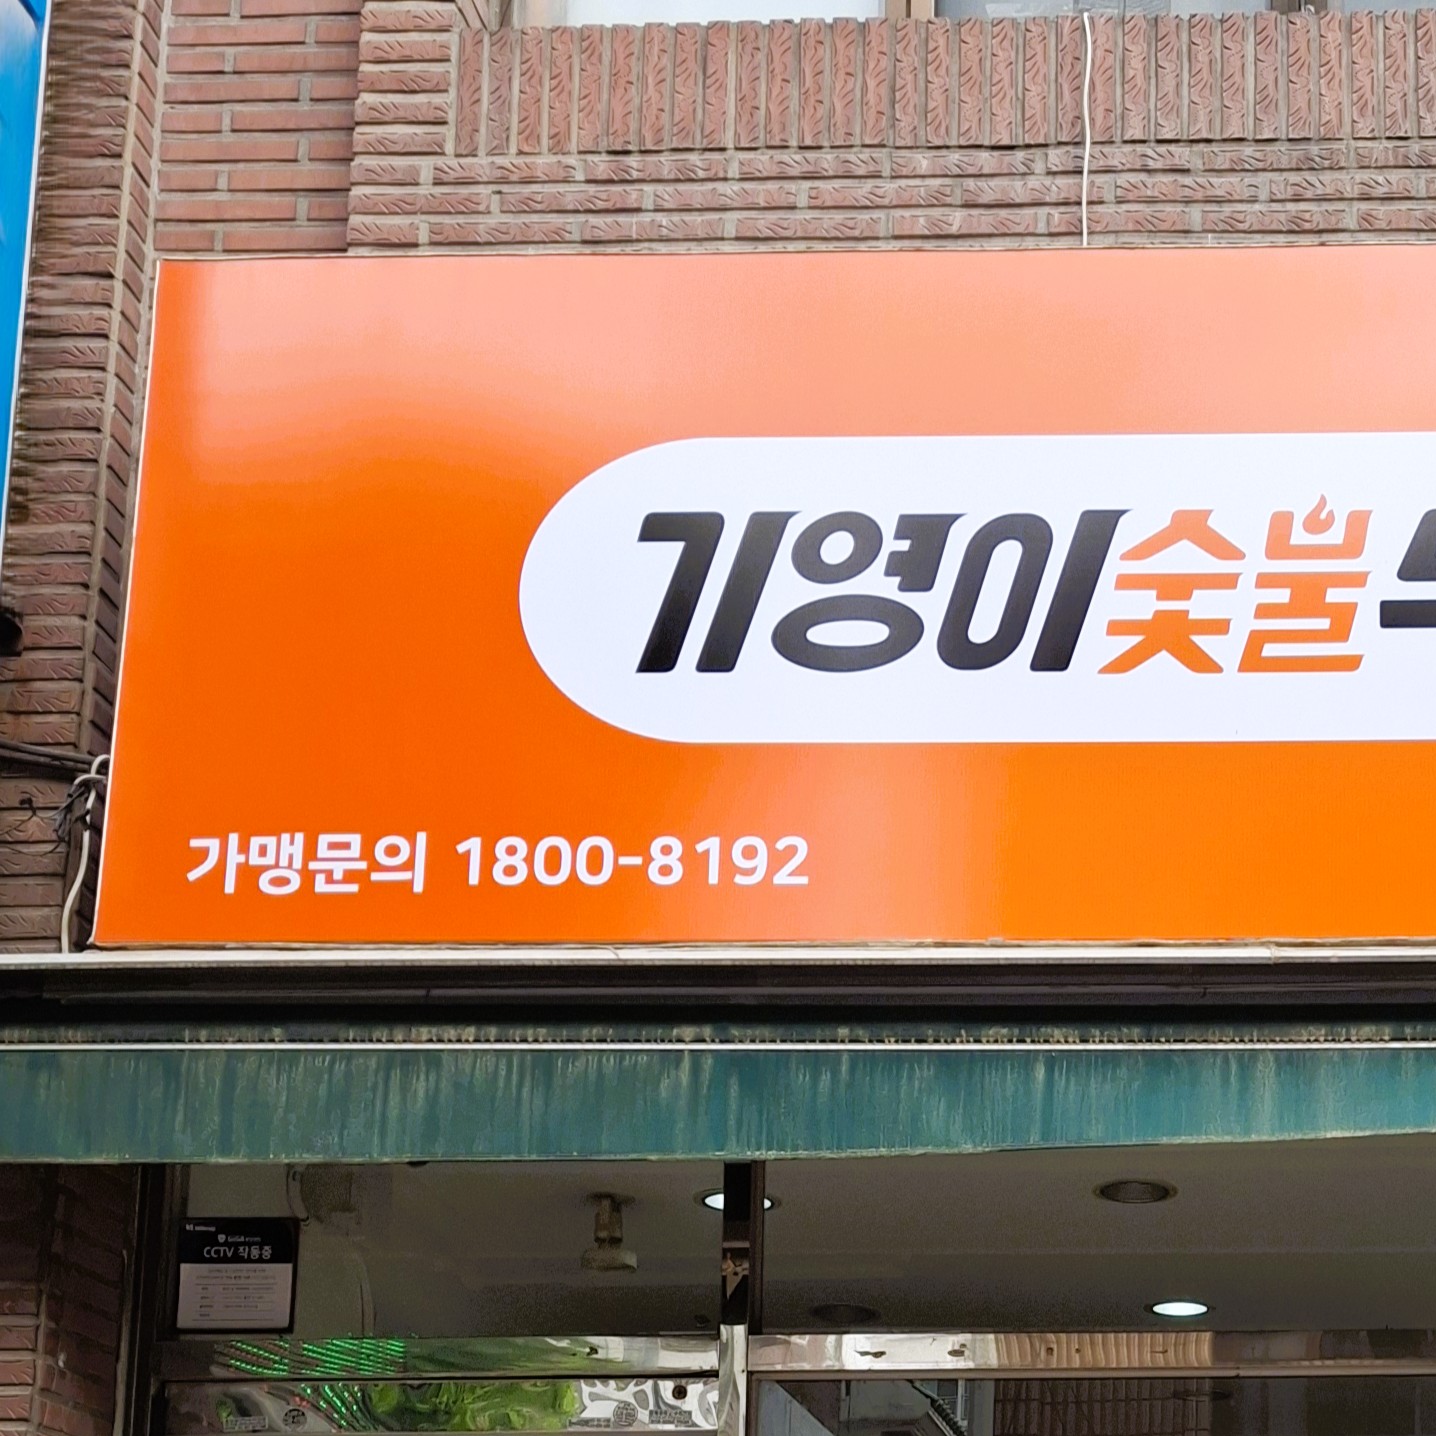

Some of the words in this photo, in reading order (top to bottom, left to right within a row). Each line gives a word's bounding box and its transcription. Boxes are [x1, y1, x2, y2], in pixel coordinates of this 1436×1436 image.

[185, 829, 428, 895] 가맹문의
[455, 834, 809, 888] 1800-8192
[203, 1246, 234, 1258] CCTV
[238, 1245, 272, 1259] 작동중
